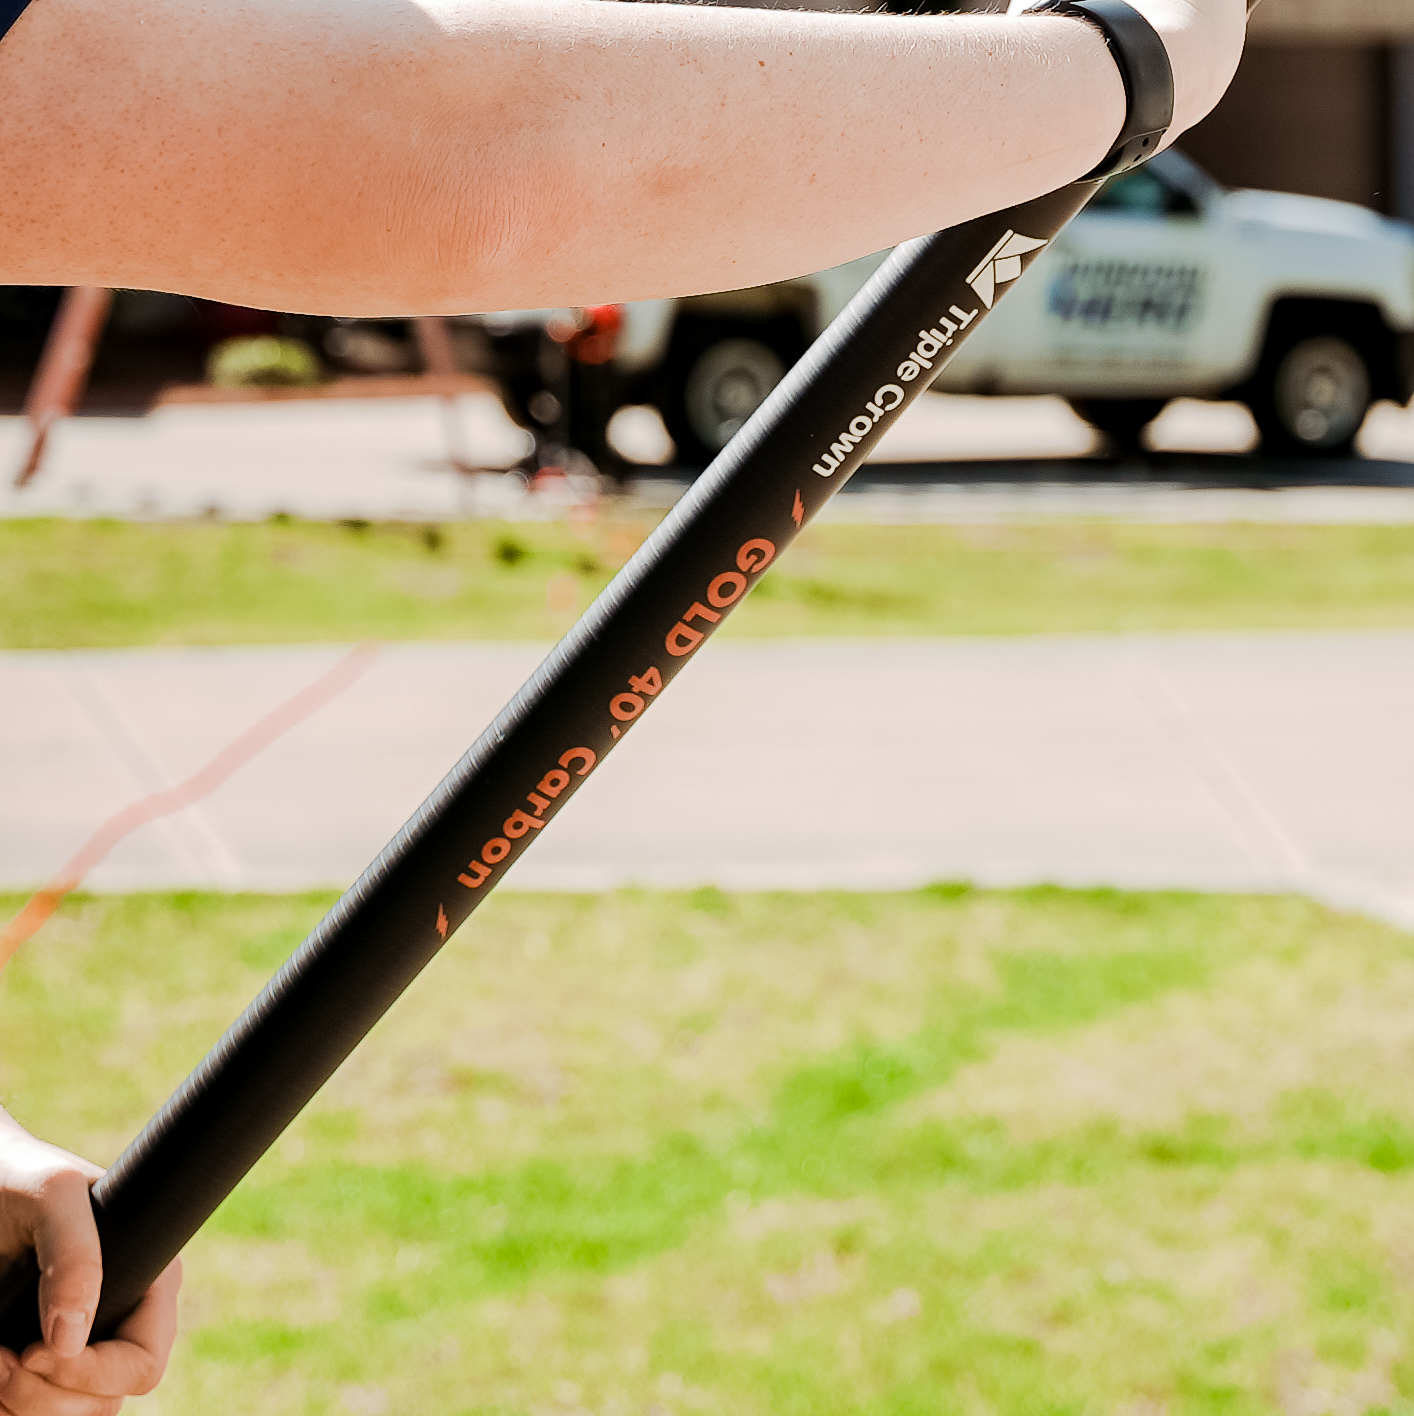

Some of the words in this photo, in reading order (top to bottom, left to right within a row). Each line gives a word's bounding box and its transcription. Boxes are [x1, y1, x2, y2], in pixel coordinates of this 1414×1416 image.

[896, 303, 979, 383] Triple
[812, 384, 905, 478] Crown
[664, 538, 777, 657] GOLD
[457, 745, 597, 890] Carbon
